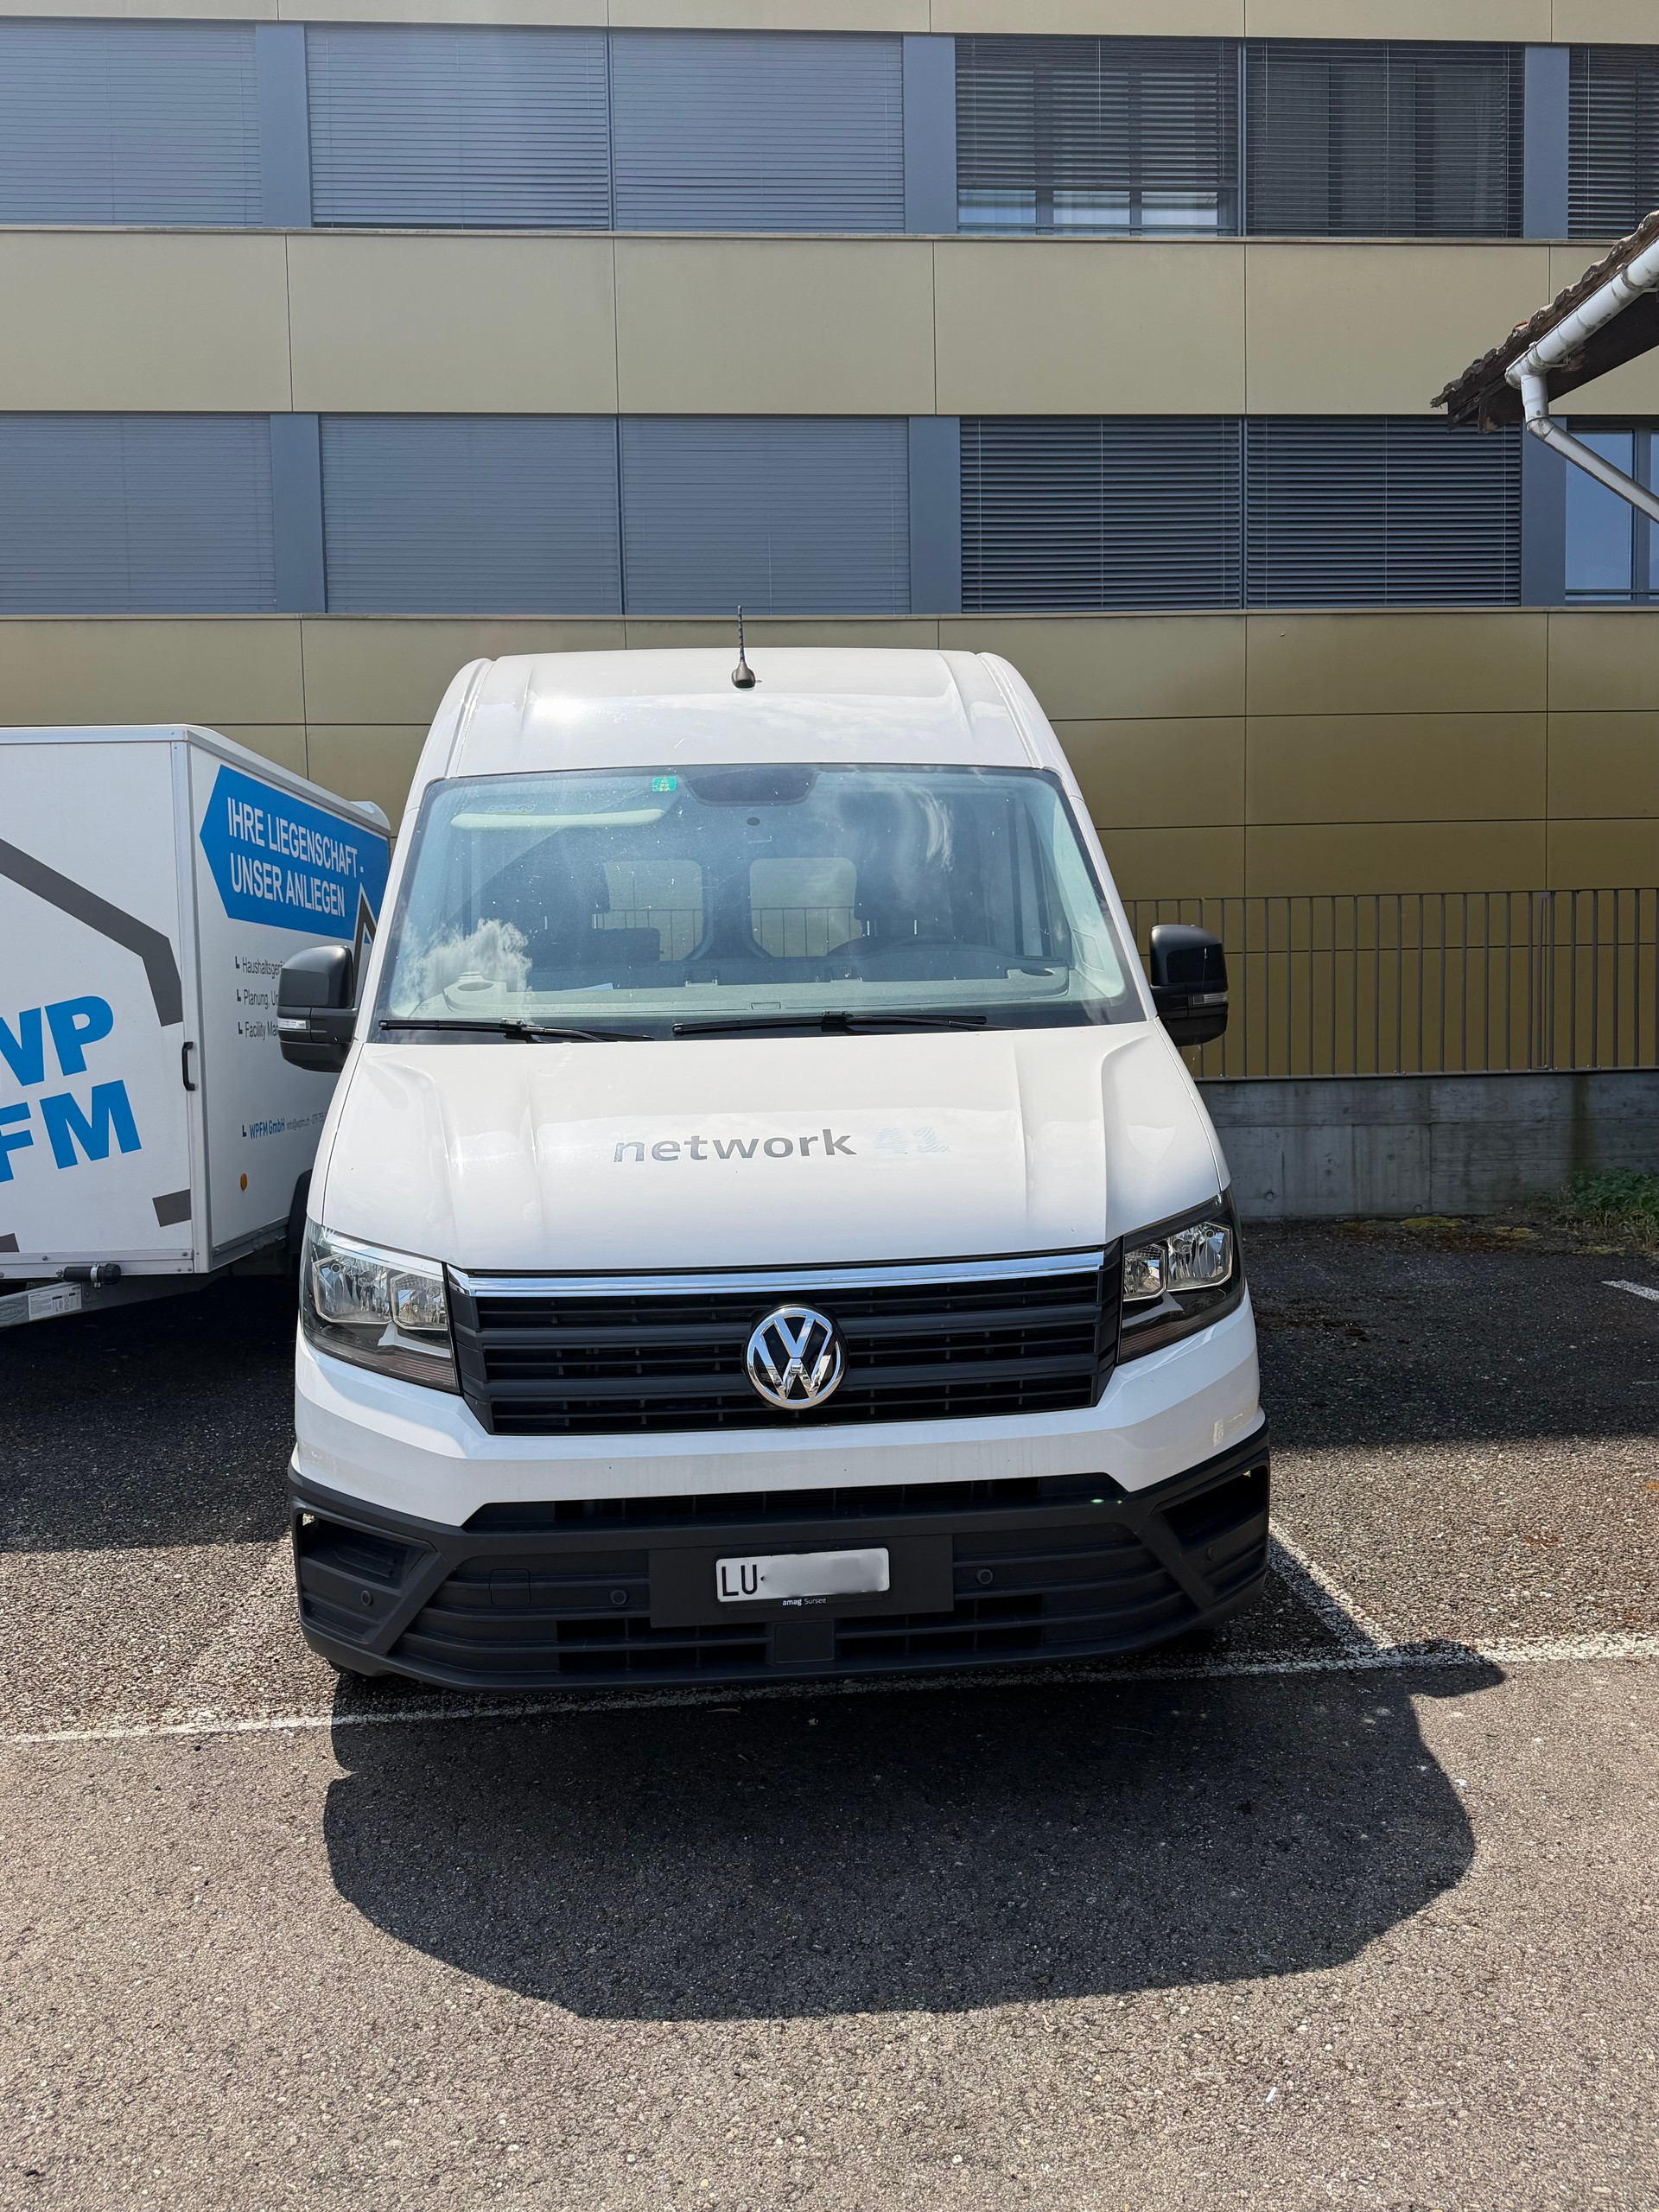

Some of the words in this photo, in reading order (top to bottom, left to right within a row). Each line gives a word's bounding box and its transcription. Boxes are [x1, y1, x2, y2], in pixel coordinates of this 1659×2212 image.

[227, 797, 265, 847] IHRE
[268, 814, 358, 878] LIEGENSCHAFT
[230, 852, 283, 903] UNSER
[286, 870, 346, 917] ANLIEGEN
[244, 989, 270, 1009] Planung,
[245, 1021, 266, 1041] Facility
[249, 1121, 268, 1140] WPFM
[269, 1117, 285, 1135] GmbH
[613, 1128, 857, 1163] network
